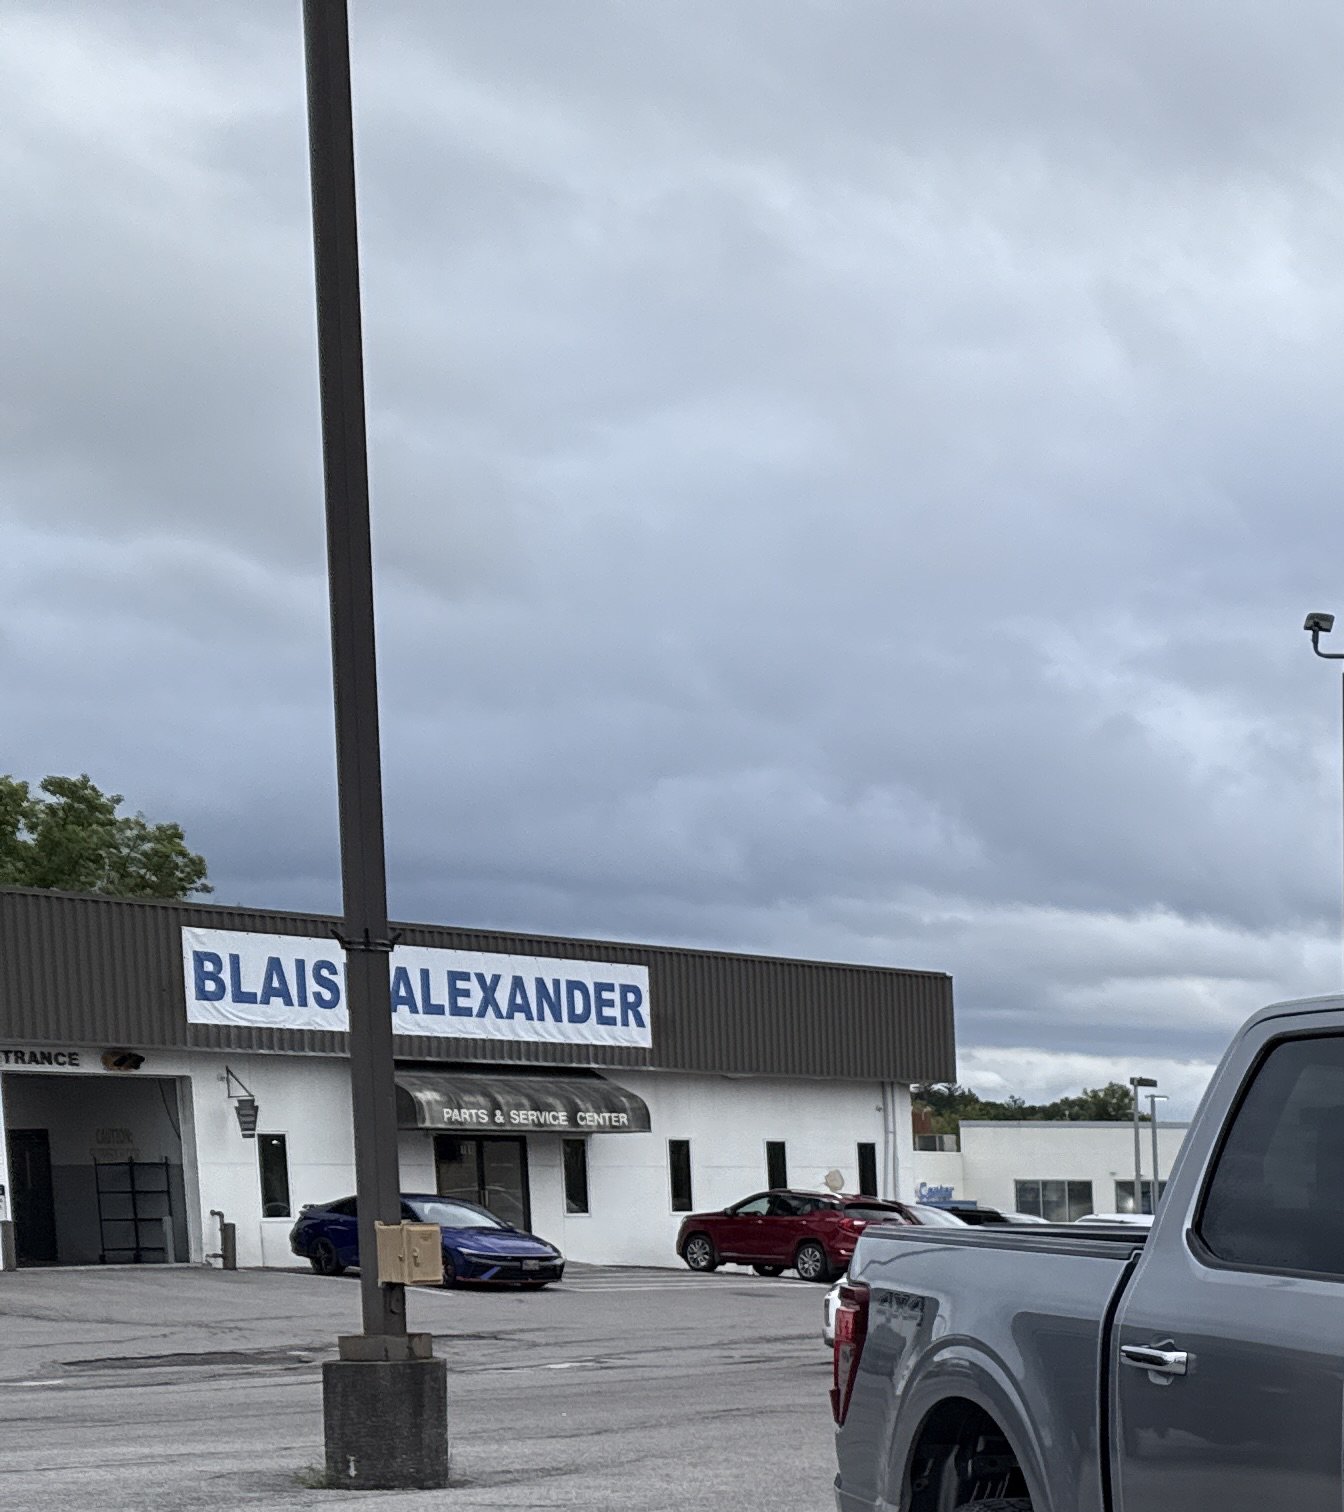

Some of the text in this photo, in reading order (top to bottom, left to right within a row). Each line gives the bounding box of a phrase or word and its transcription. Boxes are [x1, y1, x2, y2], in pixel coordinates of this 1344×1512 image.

[192, 949, 647, 1029] BLAIS ALEXANDER
[443, 1108, 629, 1126] PARTS & SERVICE CENTER
